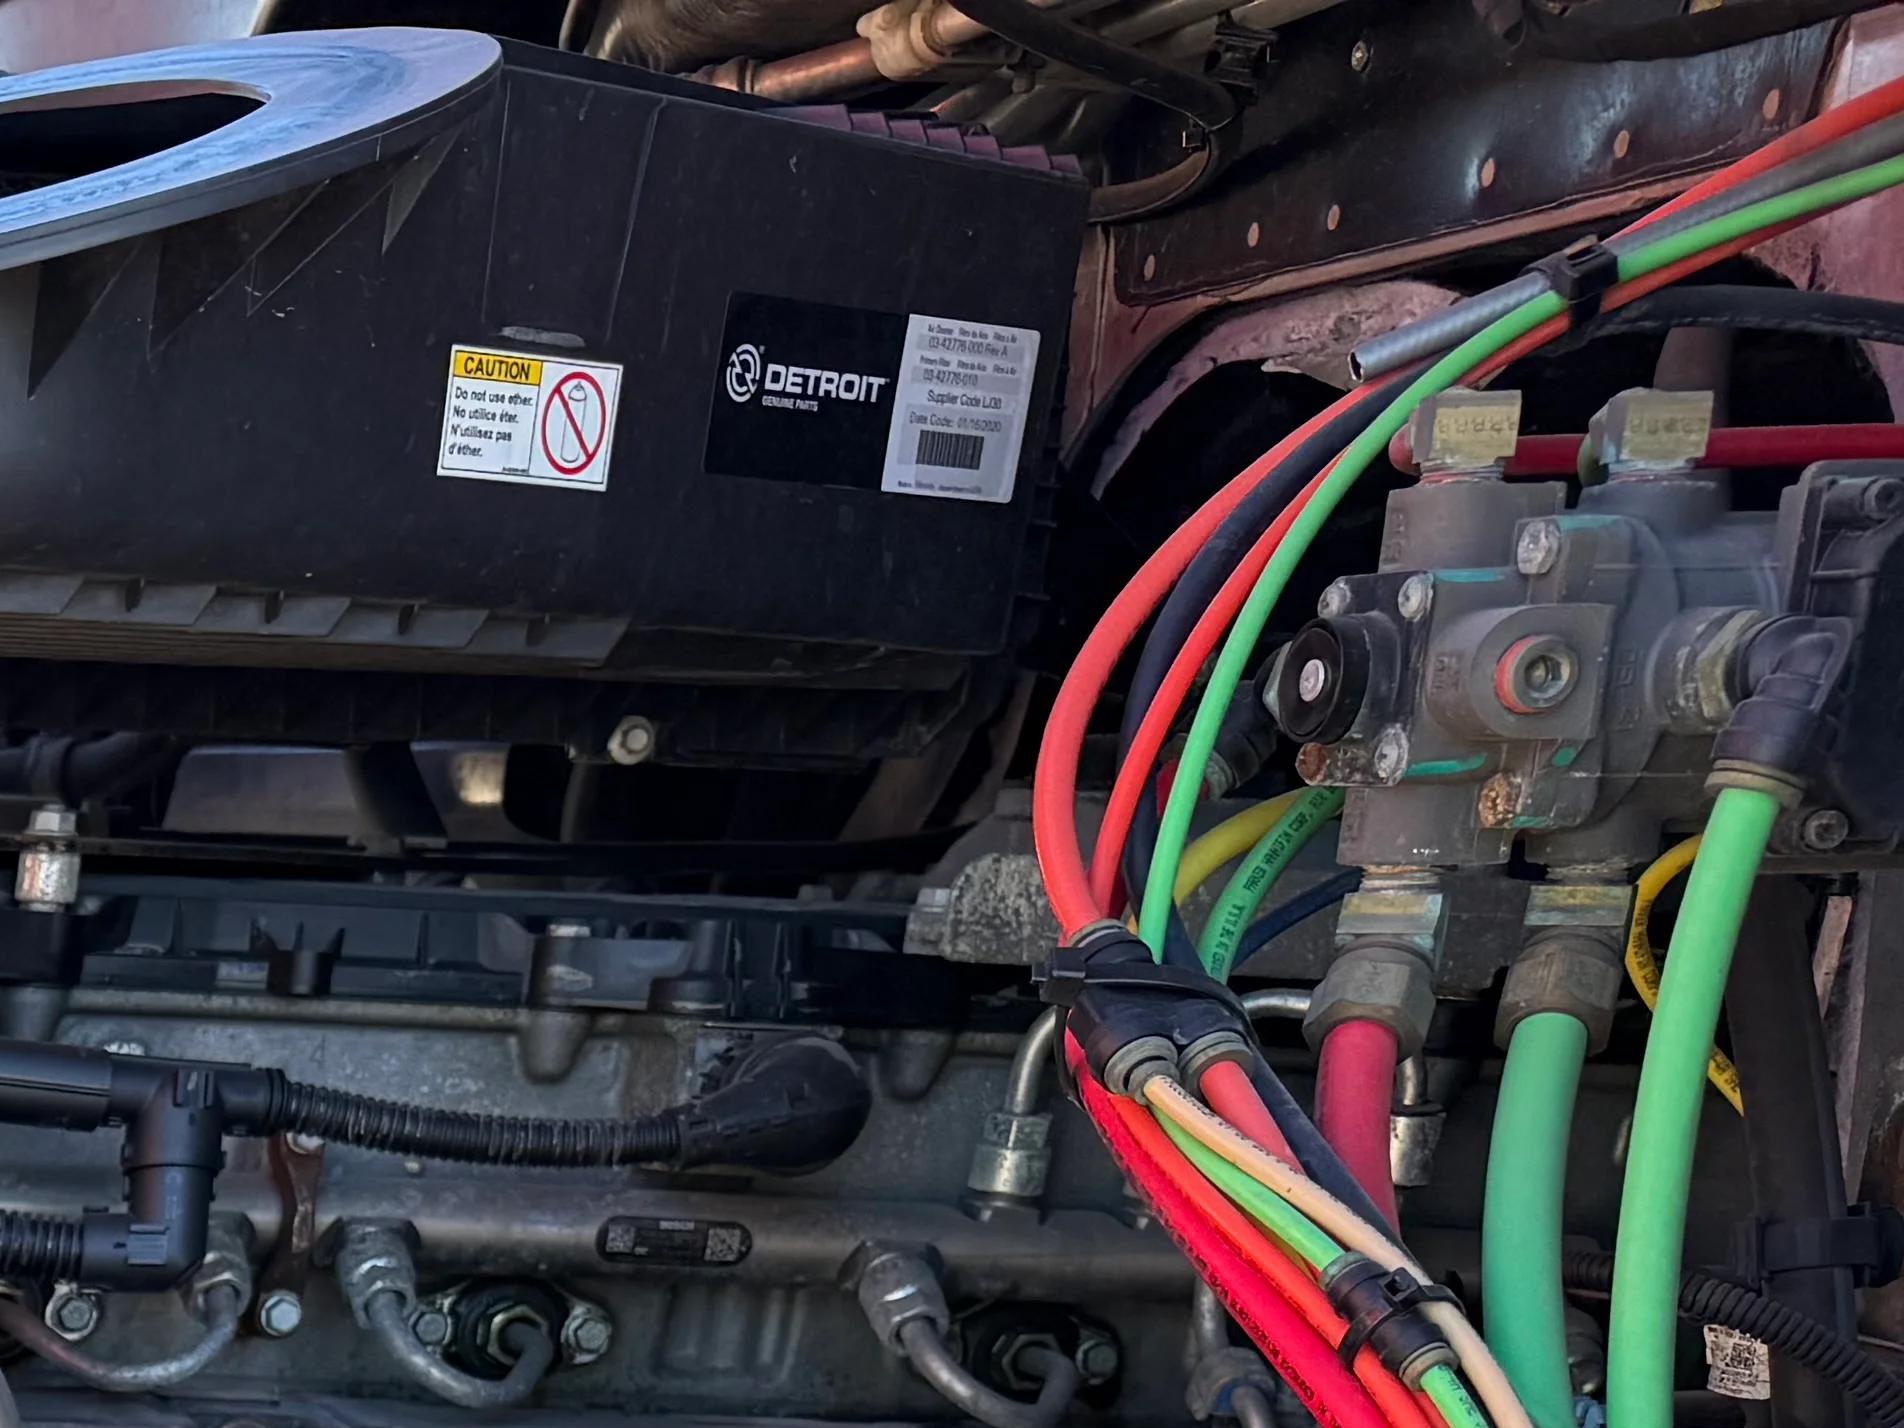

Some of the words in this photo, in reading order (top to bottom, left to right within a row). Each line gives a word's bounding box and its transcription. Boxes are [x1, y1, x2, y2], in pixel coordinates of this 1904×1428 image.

[463, 355, 532, 381] CAUTION
[764, 363, 886, 403] DETROIT
[454, 386, 468, 400] Do
[471, 388, 486, 401] not
[489, 391, 507, 404] use
[507, 392, 534, 407] ether.
[762, 395, 795, 410] GENUINE
[927, 389, 960, 406] Supplier
[959, 393, 982, 407] Code
[452, 405, 467, 420] No
[468, 406, 498, 422] utilice
[909, 411, 928, 425] Date
[450, 424, 494, 441] N'utilisez
[495, 430, 513, 444] pas
